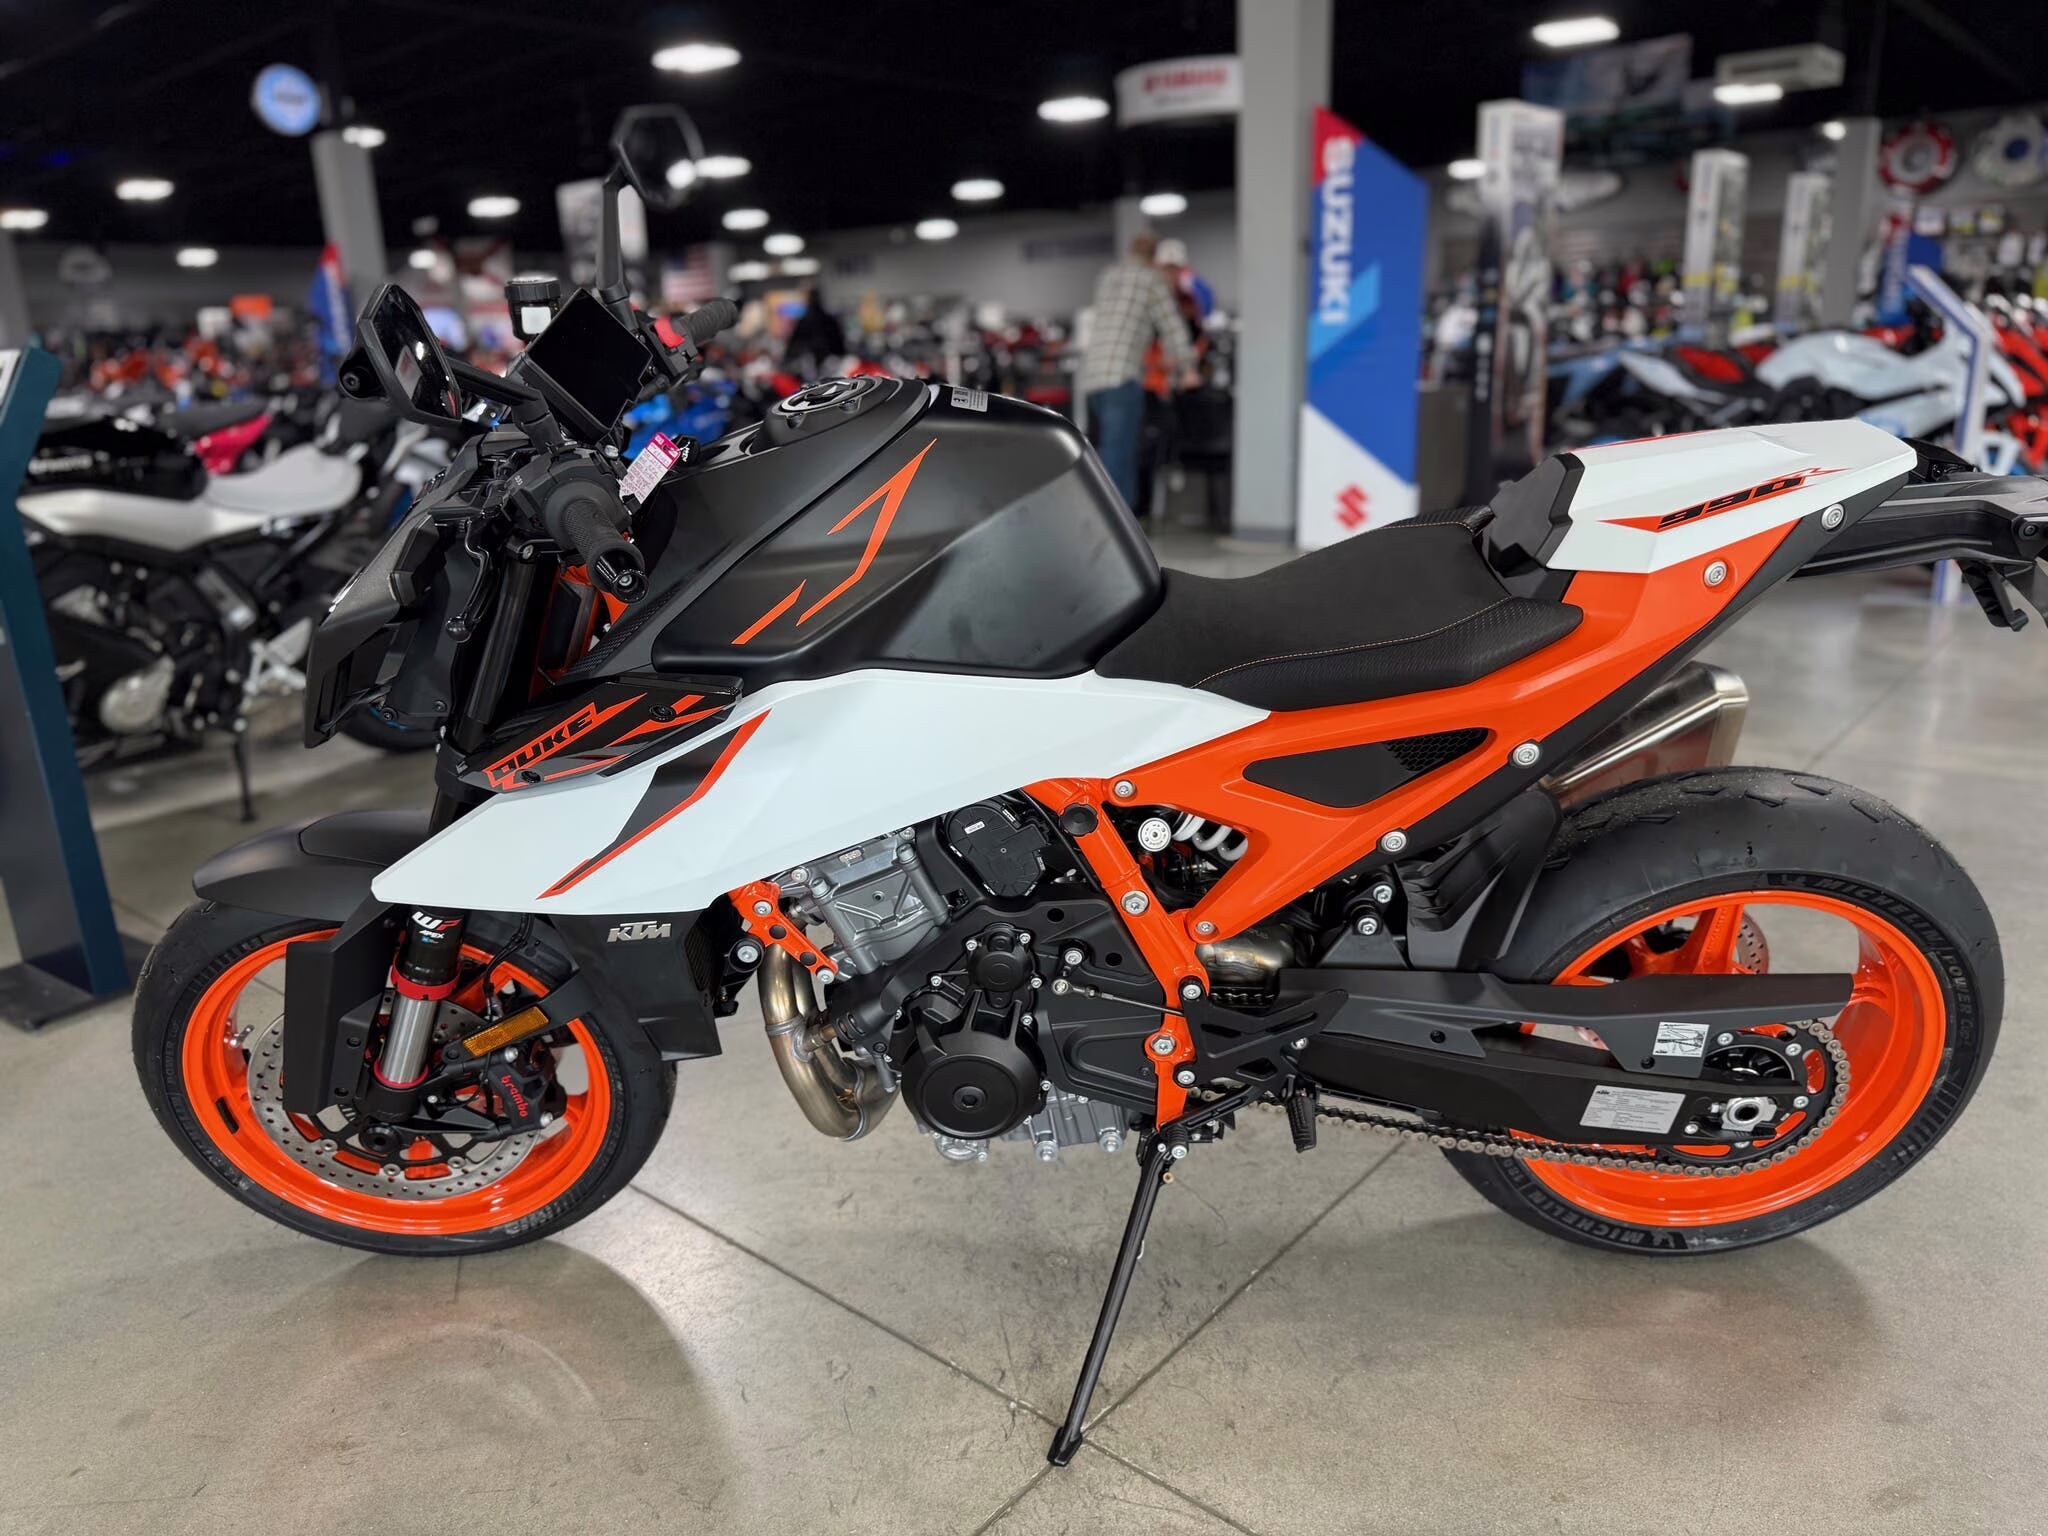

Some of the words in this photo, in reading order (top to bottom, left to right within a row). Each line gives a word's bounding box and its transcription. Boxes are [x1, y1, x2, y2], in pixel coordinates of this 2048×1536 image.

[1320, 136, 1355, 324] SUZUKI
[1657, 476, 1804, 530] 990
[489, 709, 594, 783] DUKE
[411, 911, 462, 931] WP
[419, 930, 445, 939] APEX
[606, 920, 671, 943] KTM
[1813, 877, 1946, 949] MICHELIN
[1941, 955, 1974, 1014] POWER
[501, 1074, 529, 1118] brembo
[1527, 1189, 1647, 1245] MICHELIN
